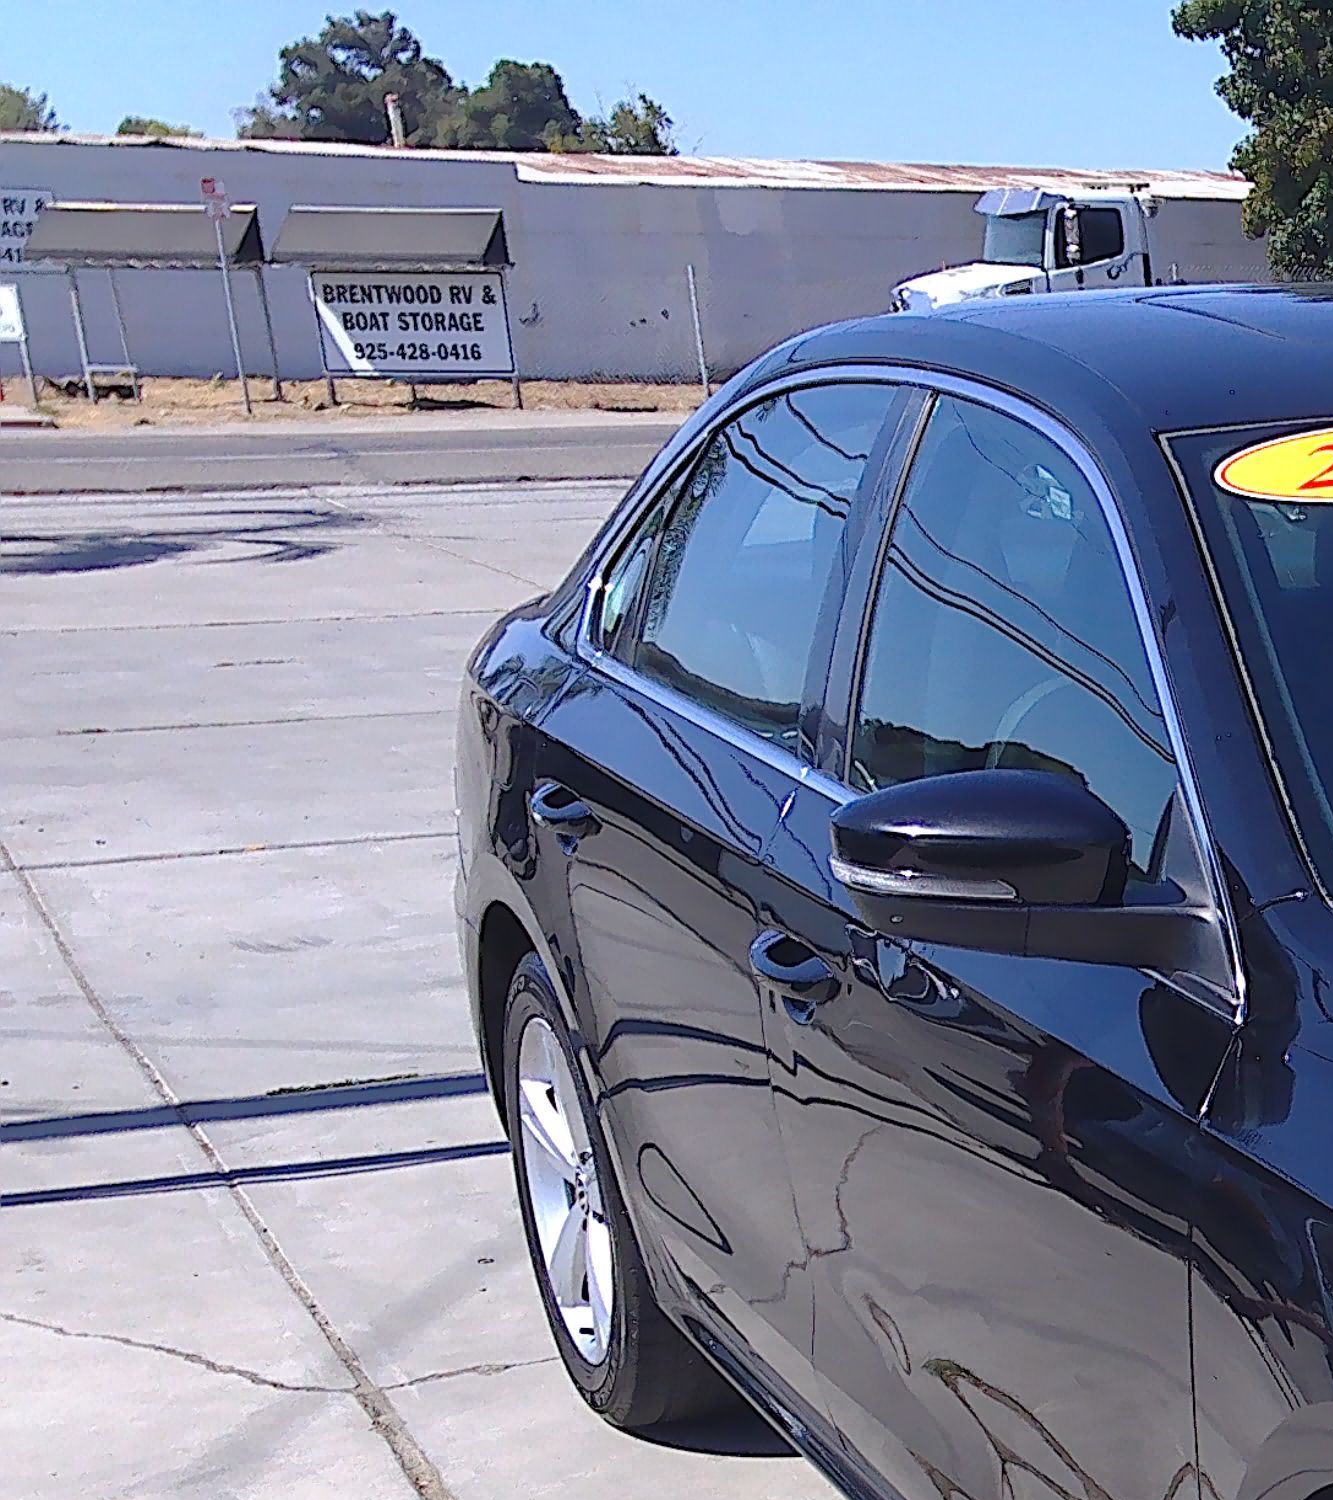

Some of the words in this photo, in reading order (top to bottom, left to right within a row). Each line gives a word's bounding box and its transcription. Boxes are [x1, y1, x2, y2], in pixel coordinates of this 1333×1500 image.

[322, 284, 442, 304] BRENTWOOD
[449, 285, 473, 304] RV
[481, 285, 496, 304] &
[342, 312, 390, 331] BOAT
[398, 312, 485, 332] STORAGE
[354, 343, 482, 360] 925-428-0416
